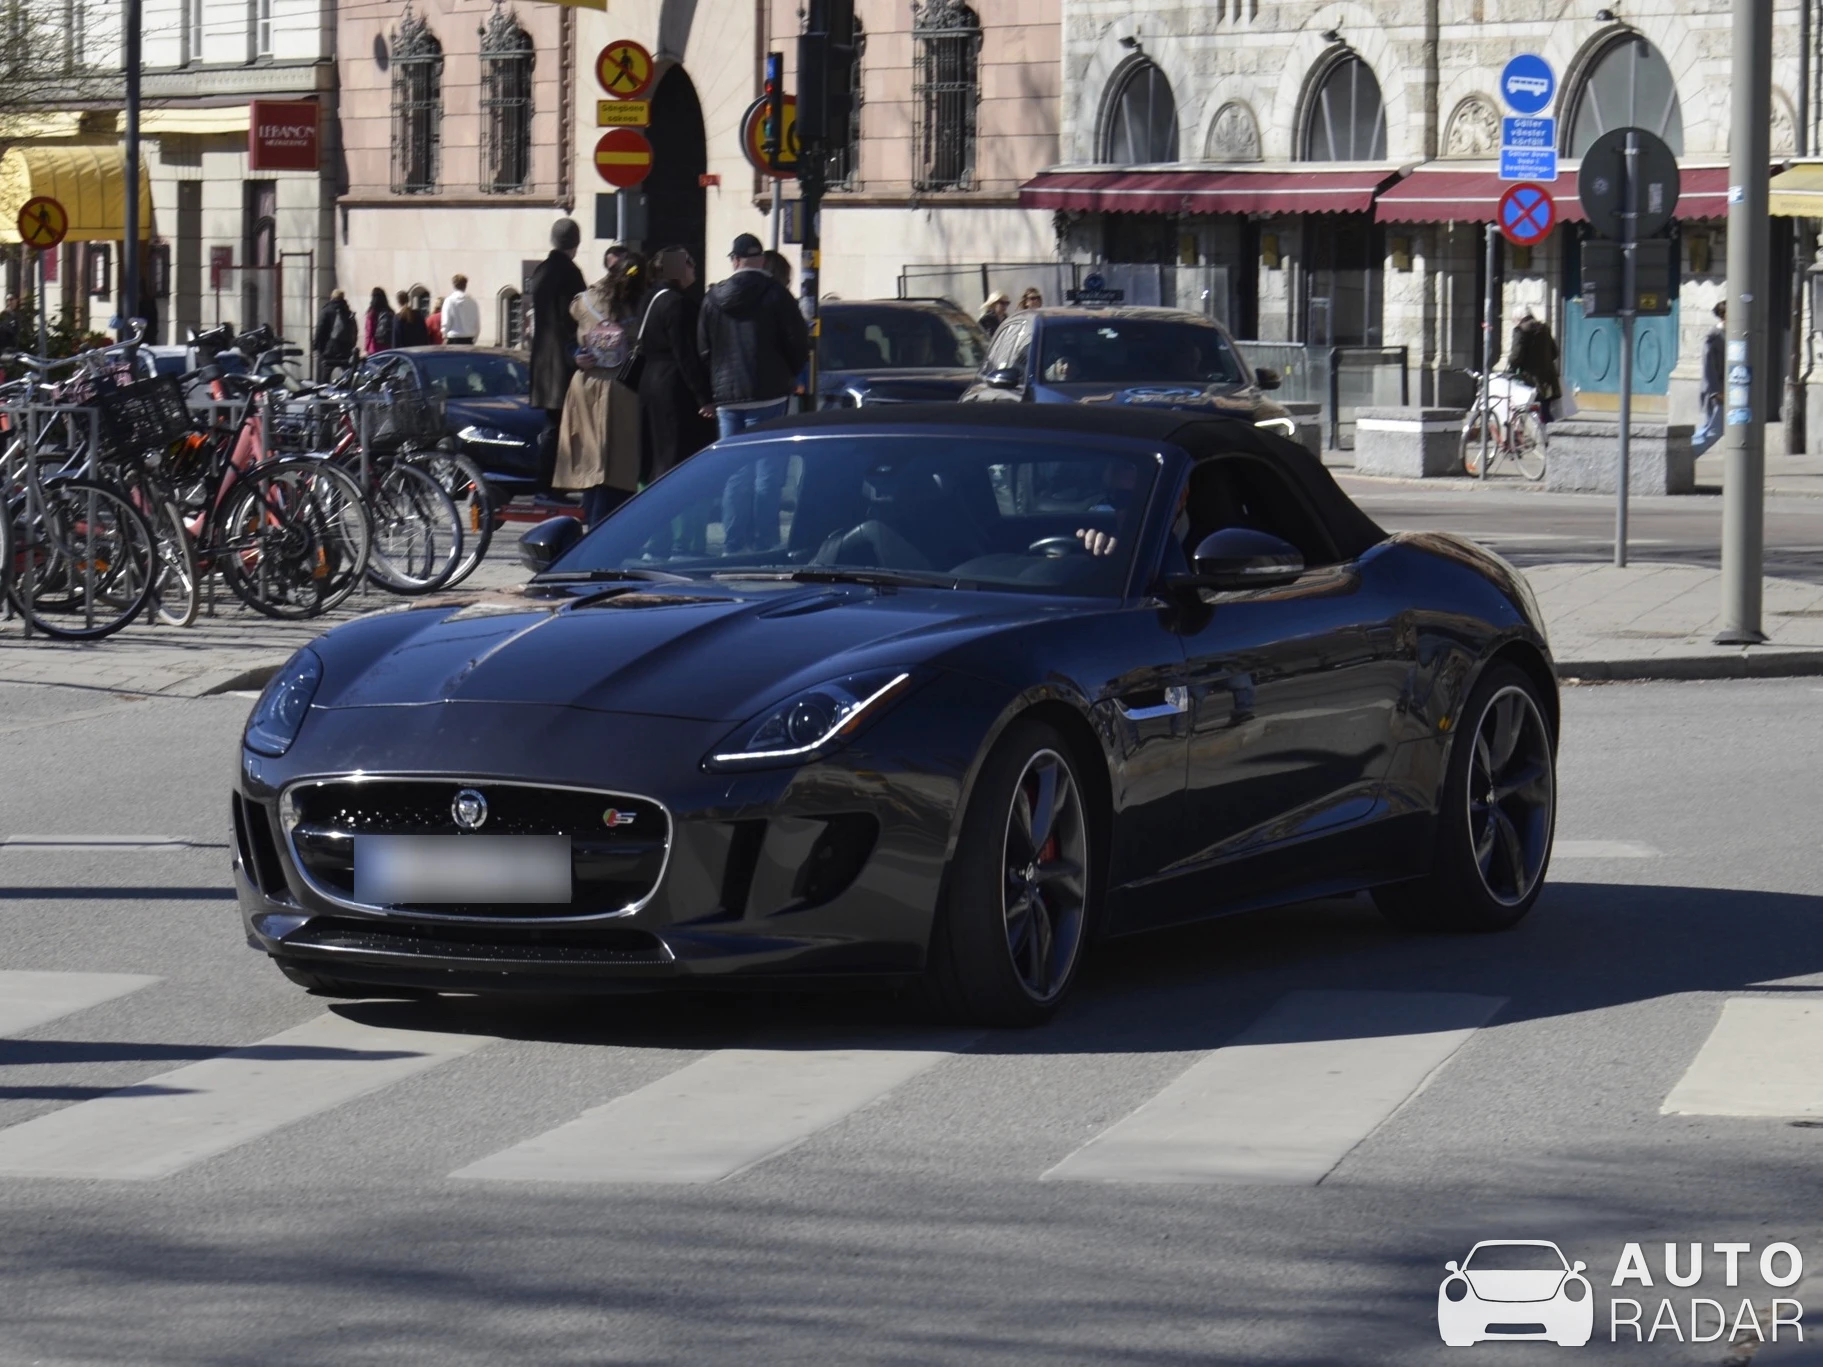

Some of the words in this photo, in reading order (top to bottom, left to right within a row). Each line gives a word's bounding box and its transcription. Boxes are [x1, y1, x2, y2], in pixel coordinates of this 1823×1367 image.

[1514, 119, 1542, 127] Gäller
[259, 125, 315, 138] LEBANON
[1511, 128, 1546, 136] vänster
[1511, 137, 1545, 146] körfält
